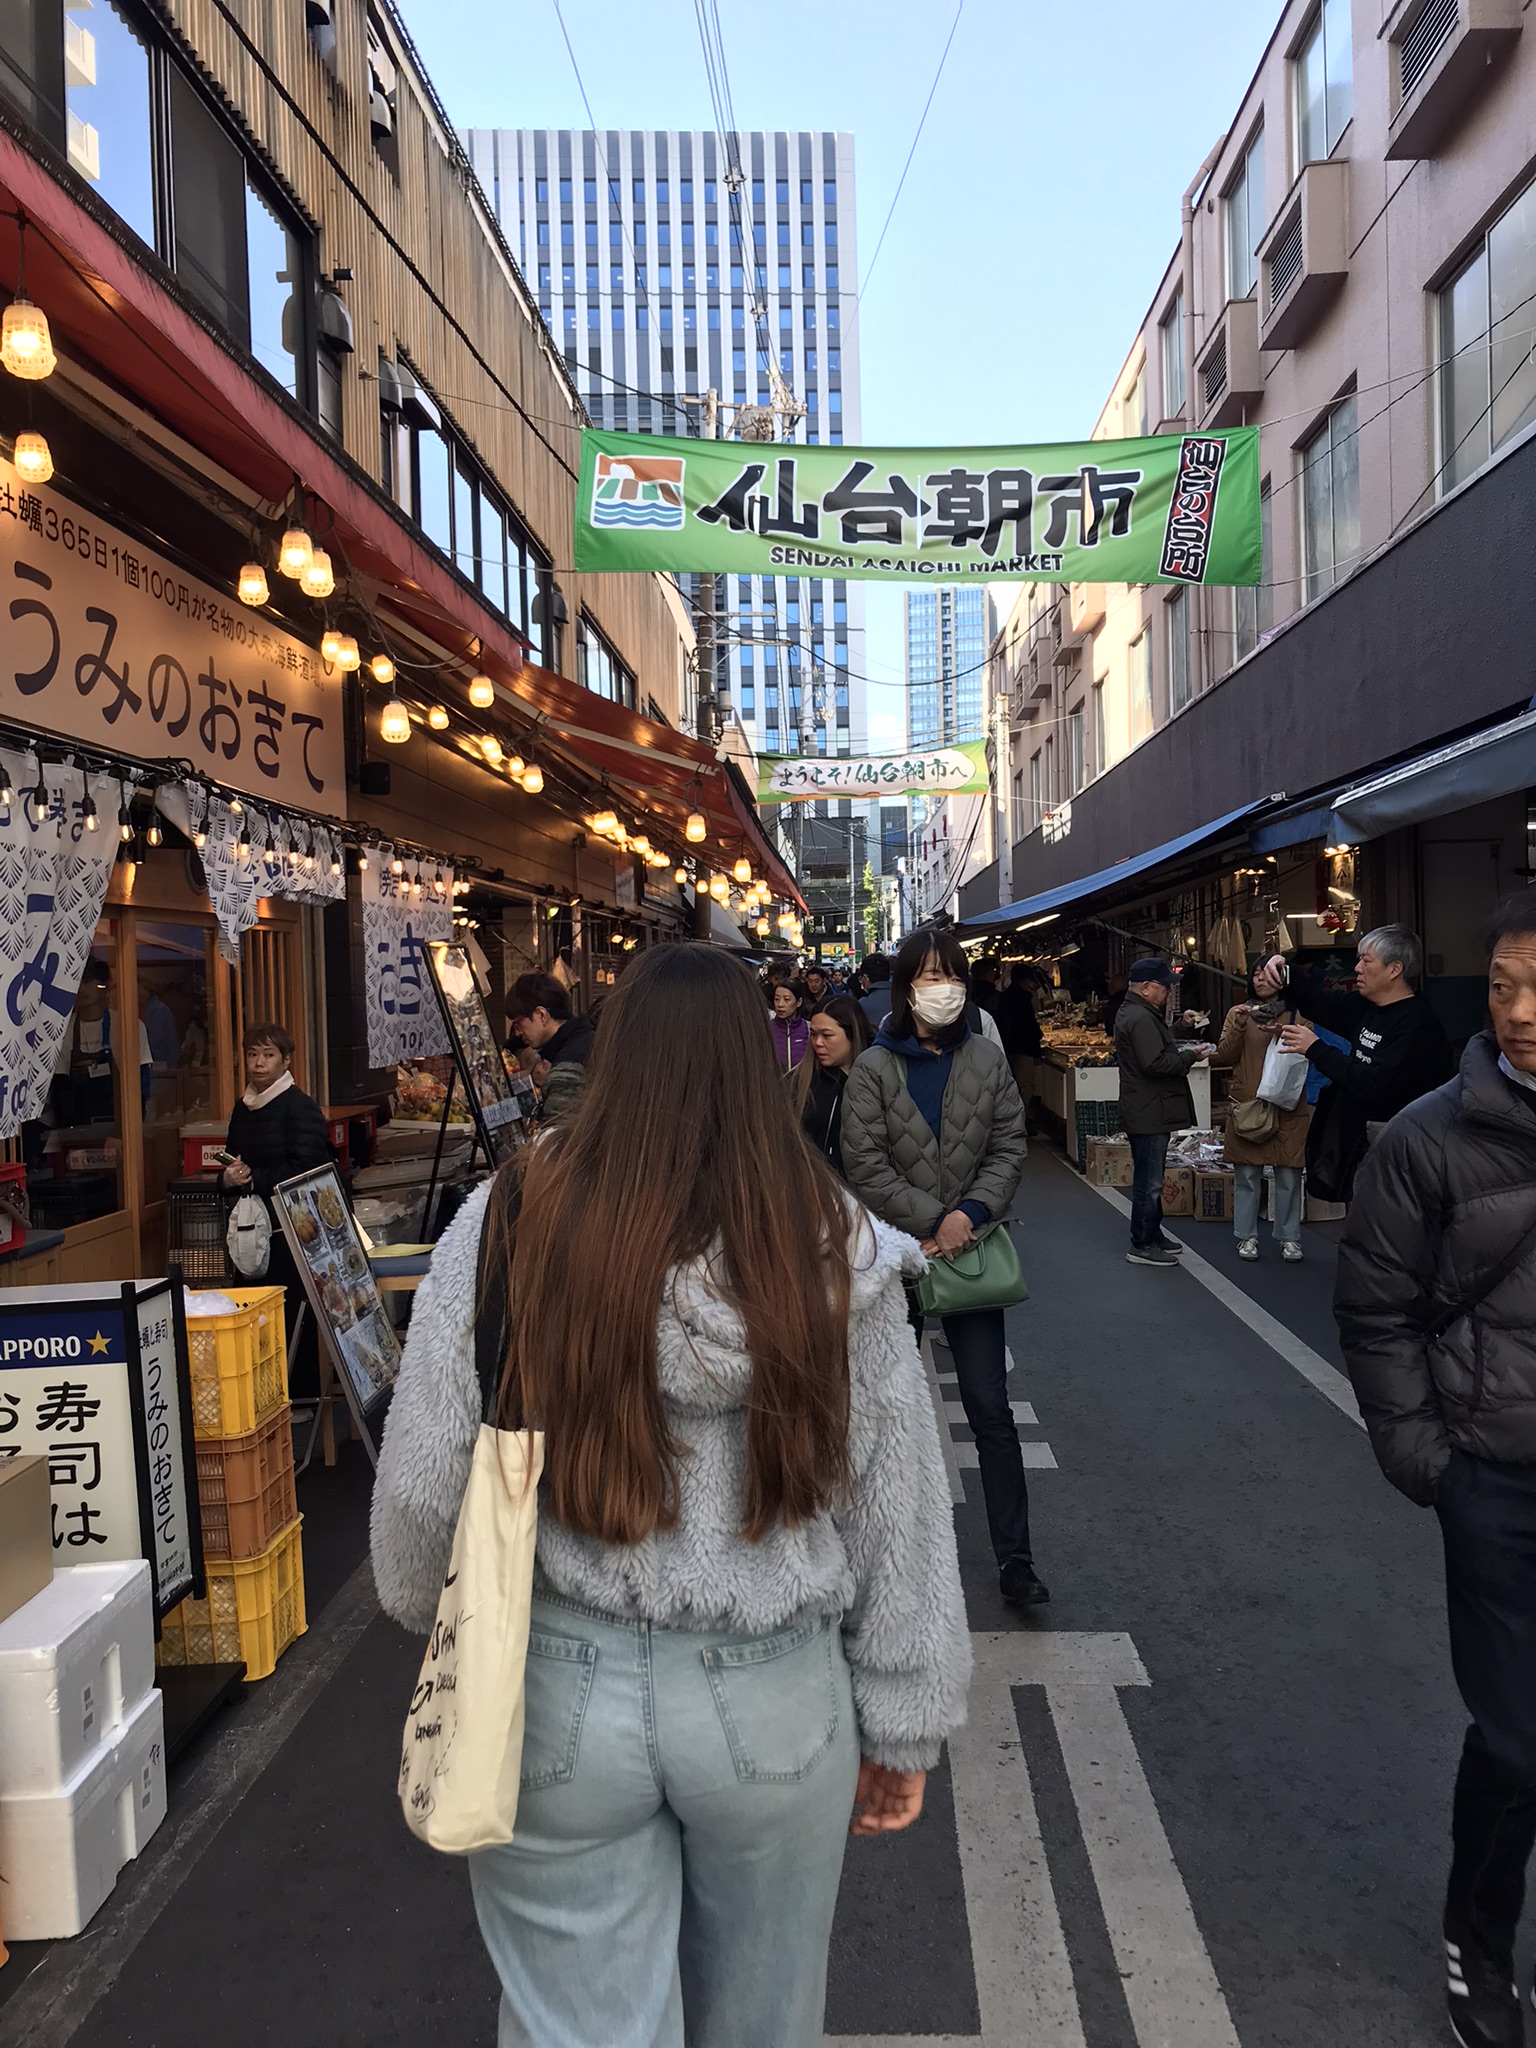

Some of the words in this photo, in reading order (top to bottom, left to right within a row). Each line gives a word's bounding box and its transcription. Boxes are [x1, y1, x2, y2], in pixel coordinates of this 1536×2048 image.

[697, 459, 1140, 556] 仙台朝市
[770, 546, 854, 568] SENDAI
[861, 558, 962, 574] ASAICHI
[969, 553, 1064, 573] MARKET
[1163, 441, 1221, 577] 仙台の台所
[9, 560, 325, 794] うみのおきて
[0, 1335, 81, 1361] PPORO
[36, 1381, 108, 1549] 寿司は
[147, 1356, 176, 1544] うみのおきて
